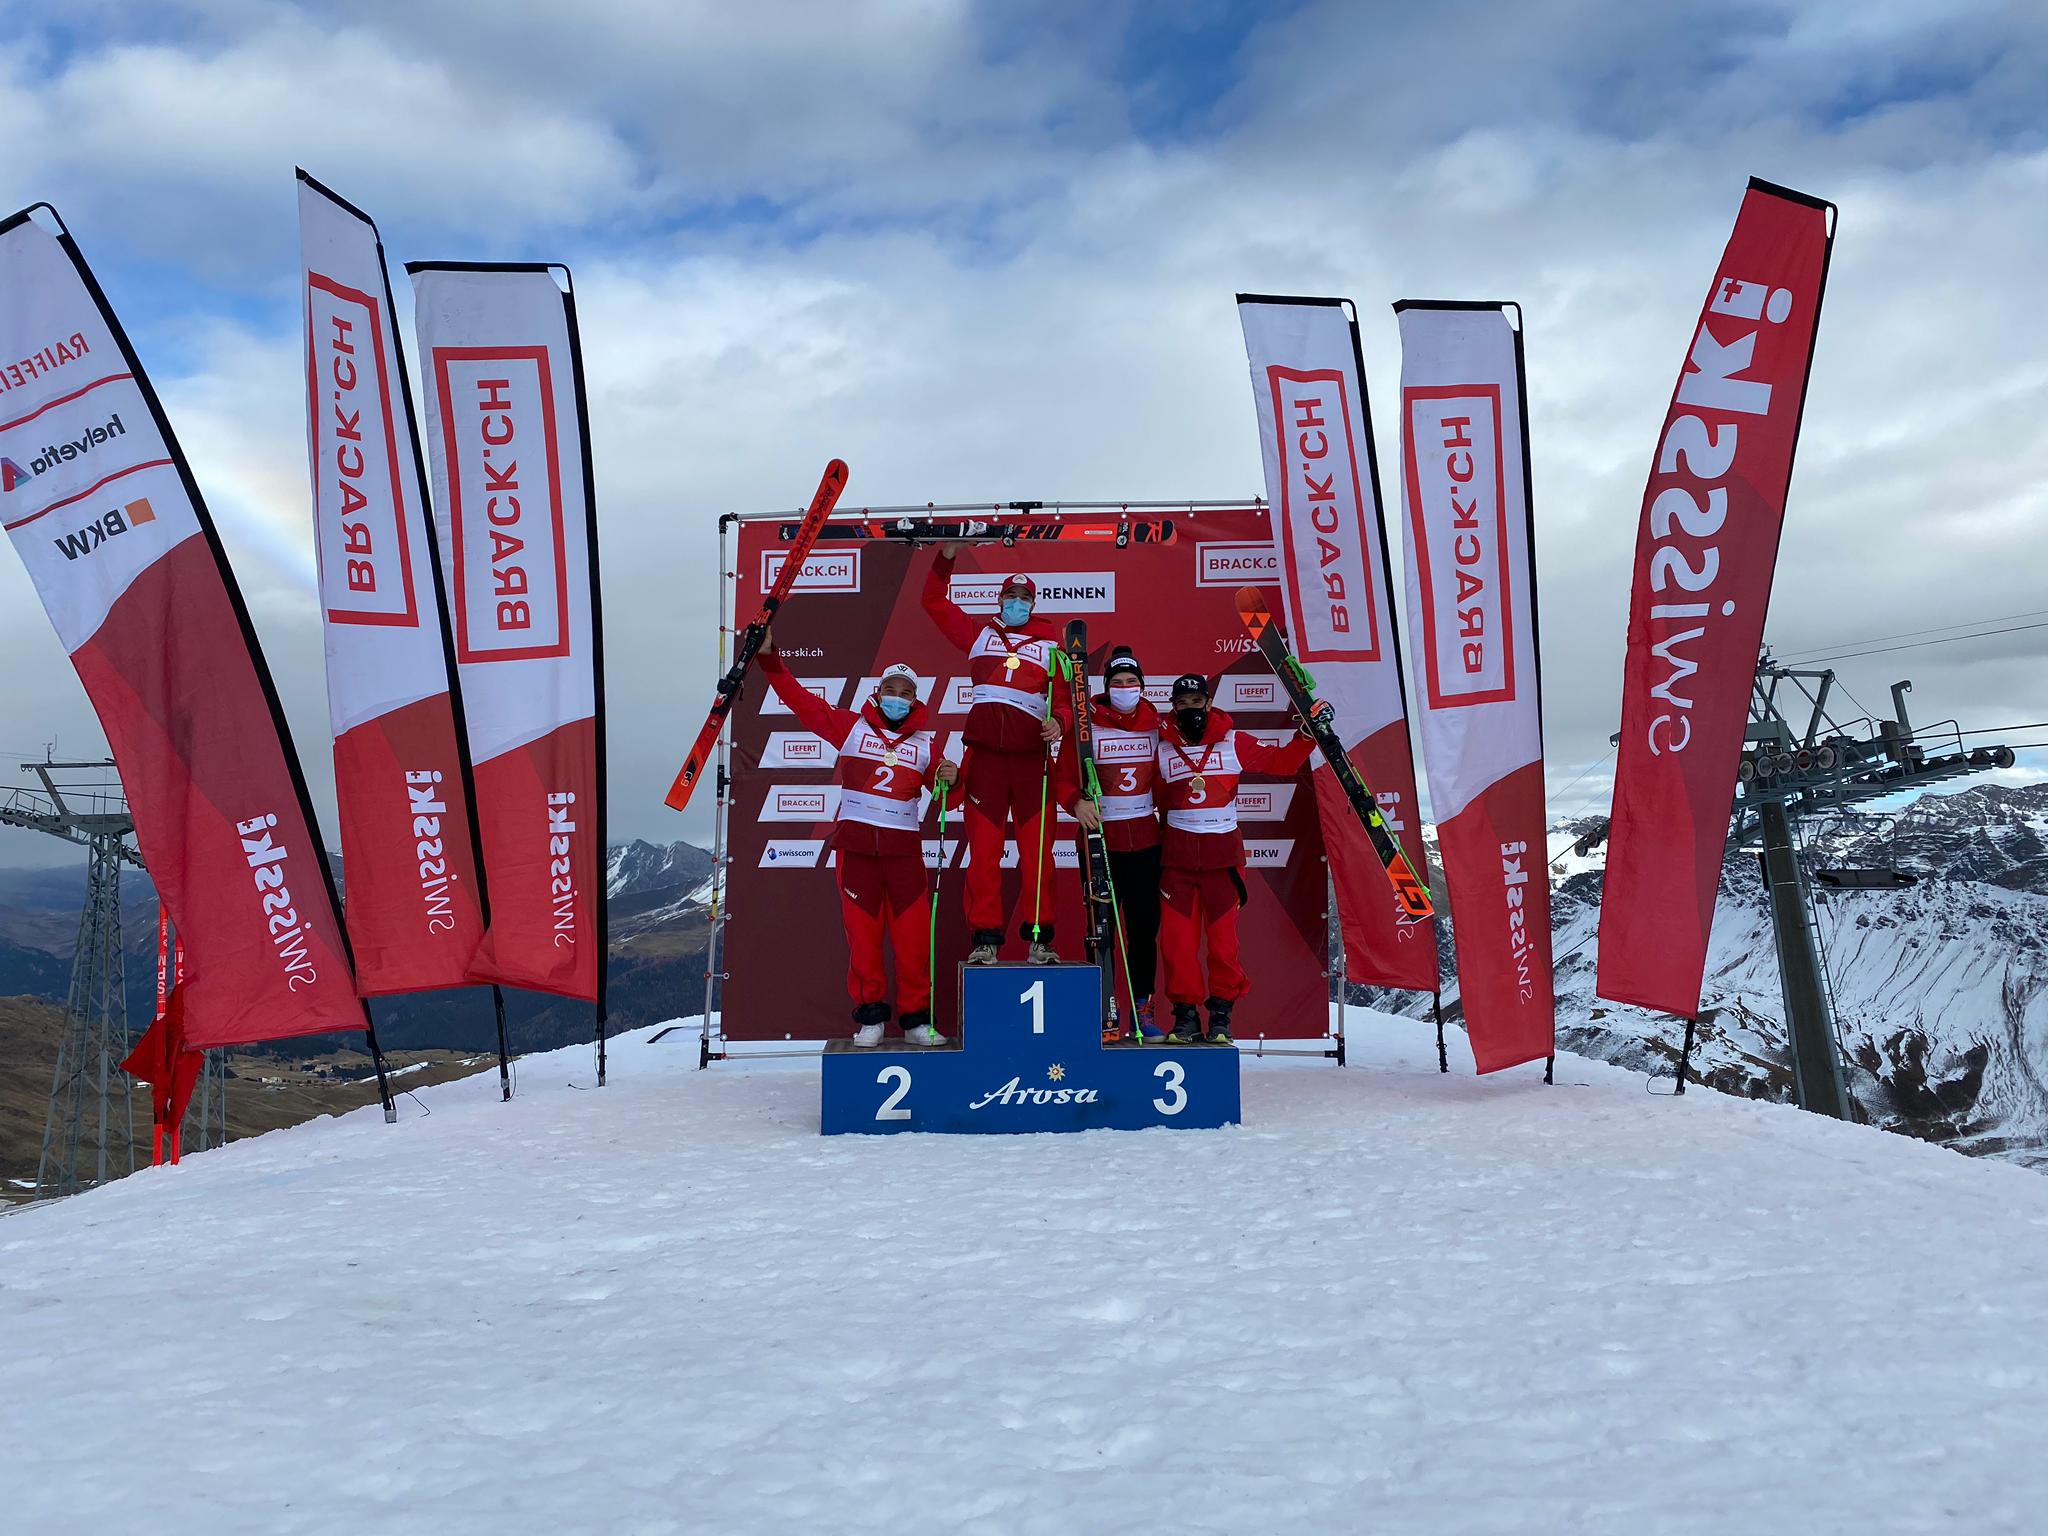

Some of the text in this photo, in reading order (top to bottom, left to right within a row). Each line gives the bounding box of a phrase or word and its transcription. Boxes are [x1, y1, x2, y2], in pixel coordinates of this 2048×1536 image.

[1209, 557, 1277, 570] BRACK.C
[773, 565, 848, 577] BACK.CH
[1037, 587, 1106, 600] -RENNEN
[1214, 633, 1261, 653] swiss
[778, 647, 824, 657] iss-ski.ch
[1239, 687, 1270, 695] LIEFERT
[1073, 663, 1090, 742] DYNASTAR
[1103, 743, 1149, 753] BRACK.CH
[872, 766, 895, 793] 2
[1118, 768, 1138, 792] 3
[1237, 797, 1267, 805] LIEFERT
[778, 849, 815, 857] swisscom
[1253, 849, 1279, 858] BKW
[1019, 980, 1045, 1034] 1
[874, 1065, 912, 1121] 2
[968, 1076, 1100, 1110] Arosa
[1153, 1060, 1188, 1116] 3
